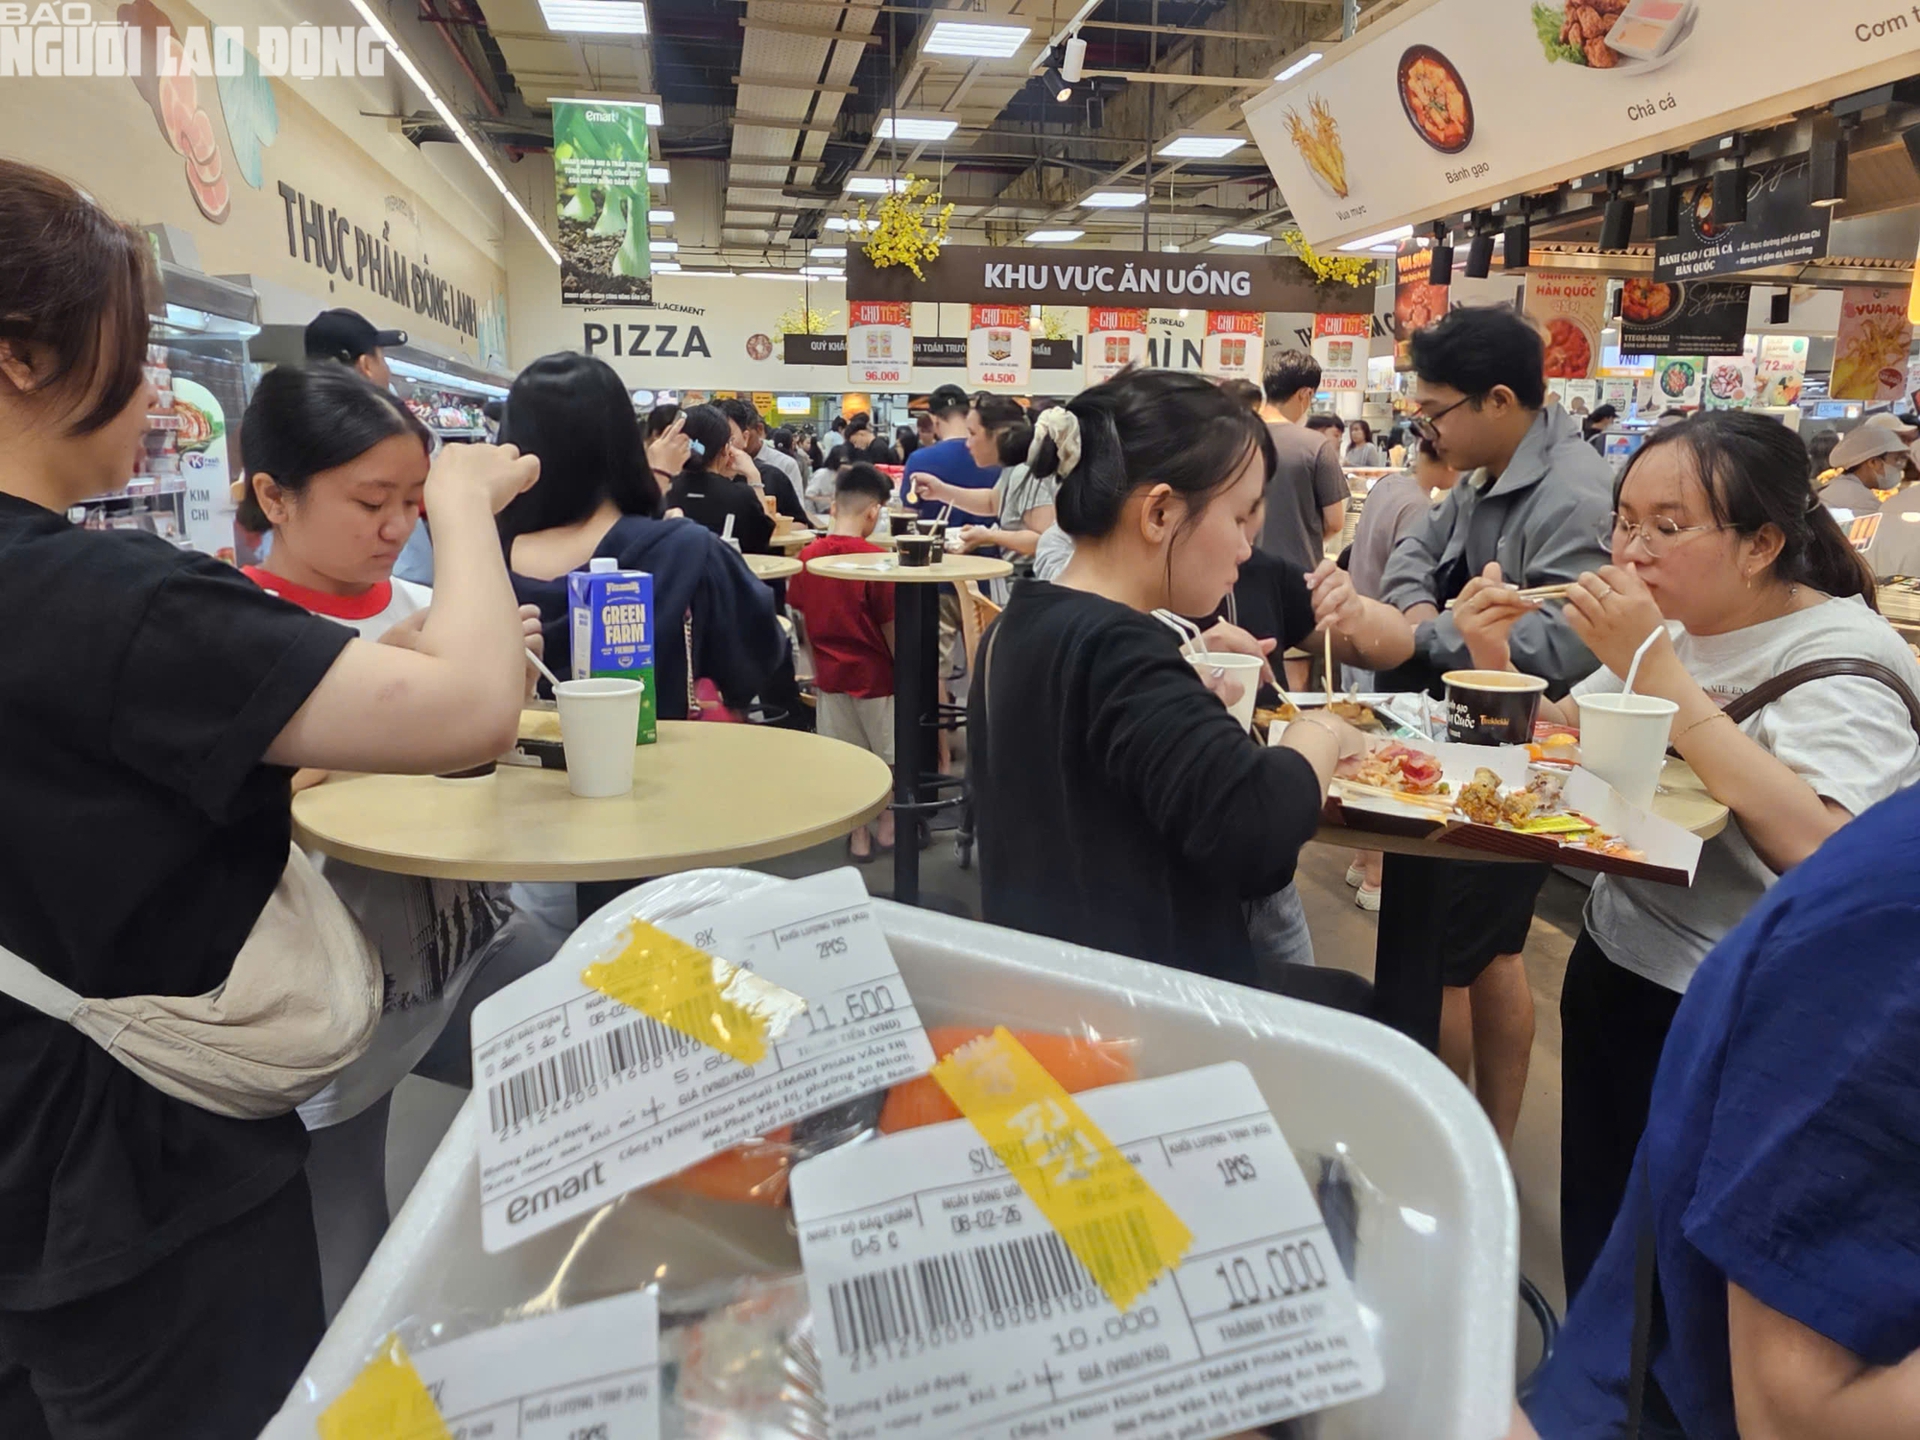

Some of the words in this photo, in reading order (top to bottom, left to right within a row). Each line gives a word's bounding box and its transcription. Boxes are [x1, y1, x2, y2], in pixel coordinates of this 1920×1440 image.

[1855, 14, 1908, 43] Cơm
[585, 110, 617, 122] emart
[1627, 99, 1656, 122] Chả
[1658, 92, 1677, 111] cá
[1445, 168, 1470, 184] Bánh
[1471, 161, 1490, 179] gạo
[278, 180, 354, 293] THỰC
[354, 221, 411, 309] PHẨM
[411, 253, 450, 326] ĐÔNG
[449, 285, 478, 345] LẠNH
[984, 263, 1048, 292] KHU
[1053, 264, 1115, 297] VỰC
[1118, 262, 1162, 293] ĂN
[1166, 262, 1252, 297] UỐNG
[1536, 282, 1560, 297] HÀN
[1563, 279, 1596, 298] QUỐC
[651, 301, 706, 317] PLACEMENT
[861, 305, 880, 324] CHỢ
[880, 304, 900, 322] TẾT
[981, 308, 1000, 327] CHỢ
[1856, 303, 1882, 316] VUA
[1100, 311, 1118, 330] CHỢ
[1159, 318, 1185, 328] BREAD
[1217, 315, 1235, 332] CHỢ
[1325, 317, 1341, 334] CHỢ
[583, 322, 712, 359] PIZZA
[811, 340, 828, 352] QUÝ
[923, 342, 944, 353] TOÁN
[945, 342, 967, 354] TRƯỚ
[1764, 360, 1795, 372] 72.000
[865, 371, 900, 381] 96.000
[982, 373, 1016, 384] 44.500
[1322, 378, 1358, 389] 157.000
[189, 490, 210, 501] KIM
[191, 509, 209, 521] CHI
[602, 603, 646, 625] GREEN
[605, 622, 645, 645] FARM
[694, 928, 717, 949] 8K
[815, 936, 849, 959] 2PCS
[868, 1019, 902, 1036] (VND)
[526, 1041, 536, 1056] 5
[561, 1025, 572, 1039] C
[678, 1089, 698, 1106] GIÁ
[1216, 1153, 1257, 1187] 1PCS
[506, 1160, 606, 1225] emart
[887, 1229, 899, 1249] C
[1052, 1305, 1160, 1356] 10.000
